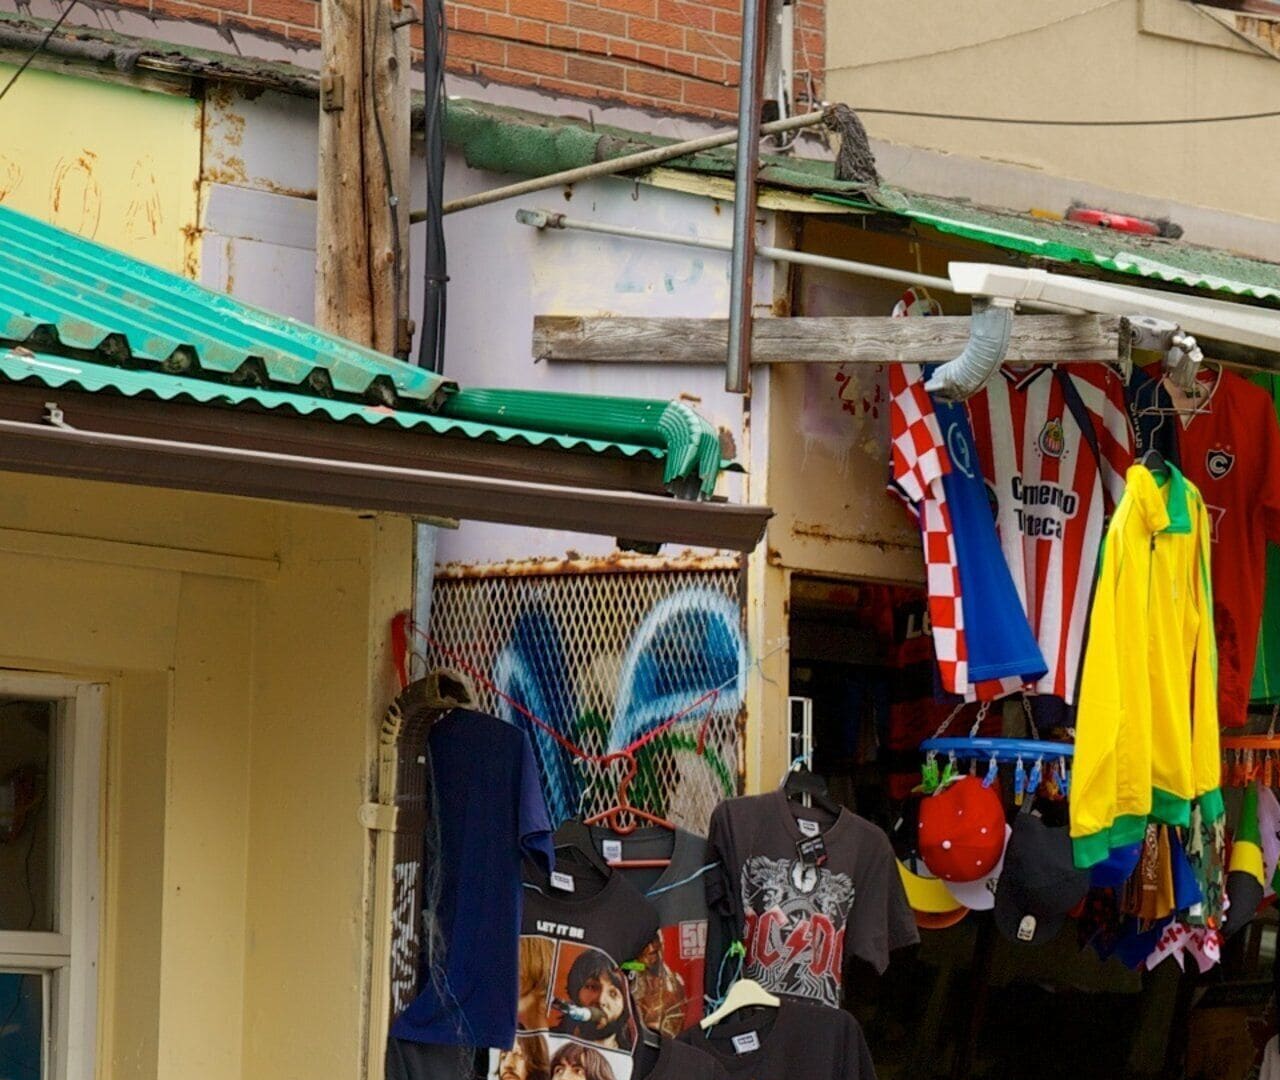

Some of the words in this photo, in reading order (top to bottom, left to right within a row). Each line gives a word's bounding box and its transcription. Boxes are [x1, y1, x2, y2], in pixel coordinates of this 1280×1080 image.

[537, 919, 557, 934] LET
[557, 923, 569, 936] IT
[569, 925, 585, 940] BE
